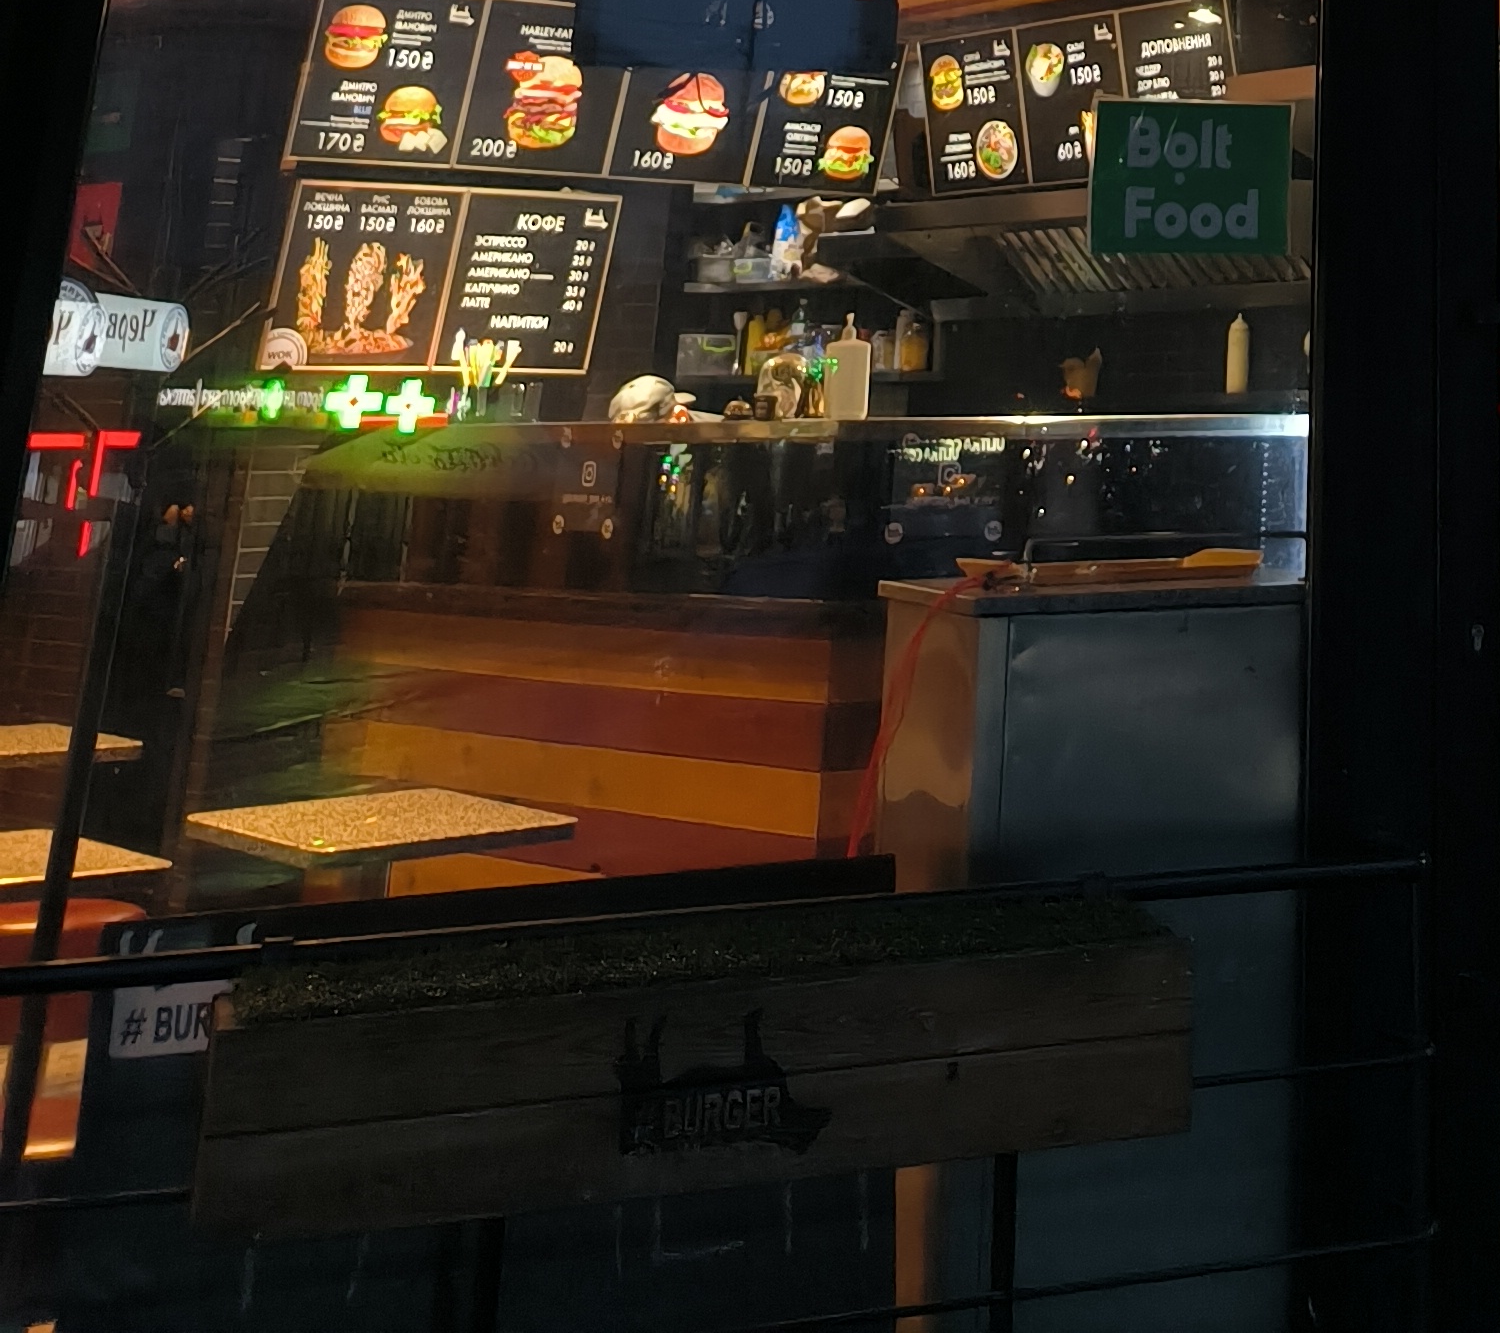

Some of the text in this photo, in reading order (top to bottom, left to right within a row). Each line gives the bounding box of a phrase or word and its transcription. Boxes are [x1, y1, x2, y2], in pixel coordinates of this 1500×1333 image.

[1127, 115, 1233, 173] Bolt
[516, 213, 566, 232] КОФЕ
[1124, 185, 1259, 240] Food
